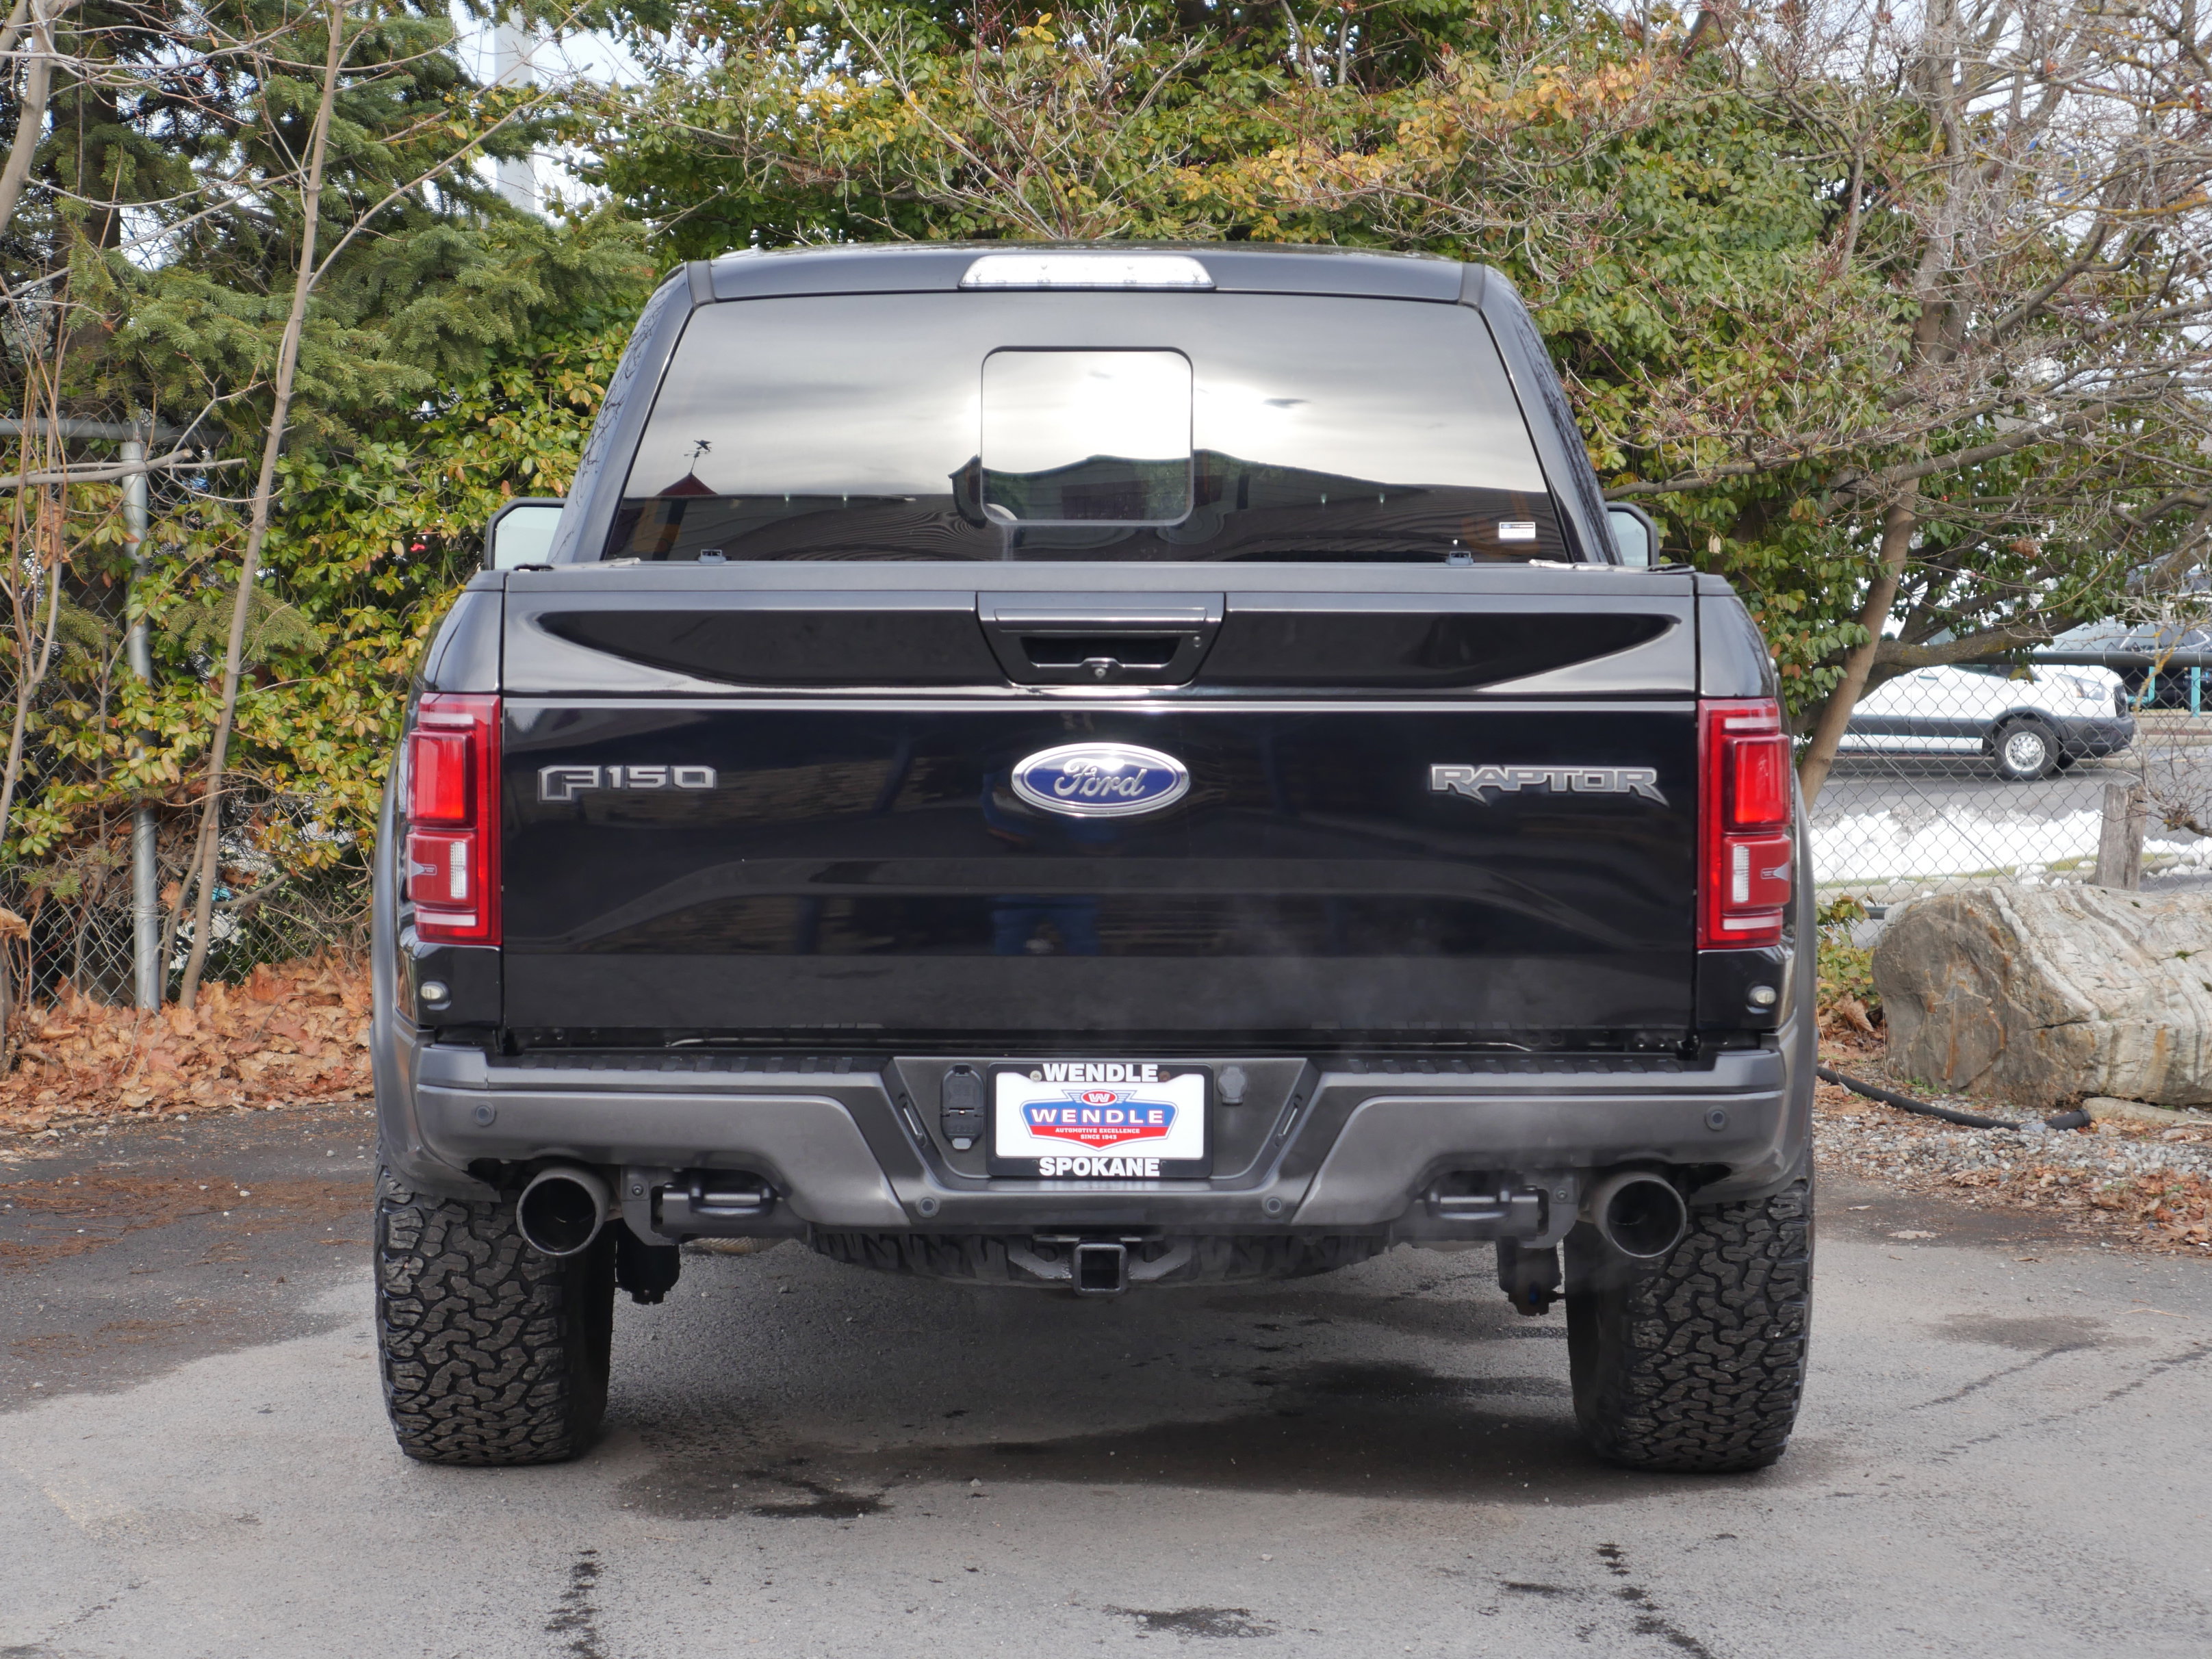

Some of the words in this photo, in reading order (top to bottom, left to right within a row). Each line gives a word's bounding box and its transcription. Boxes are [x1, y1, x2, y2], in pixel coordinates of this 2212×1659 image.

[1054, 757, 1148, 797] Ford
[1430, 764, 1670, 808] RAPTOR
[1042, 1064, 1159, 1083] WENDLE
[1088, 1092, 1110, 1103] W
[1030, 1108, 1164, 1124] WENDLE
[1038, 1157, 1160, 1177] SPOKANE
